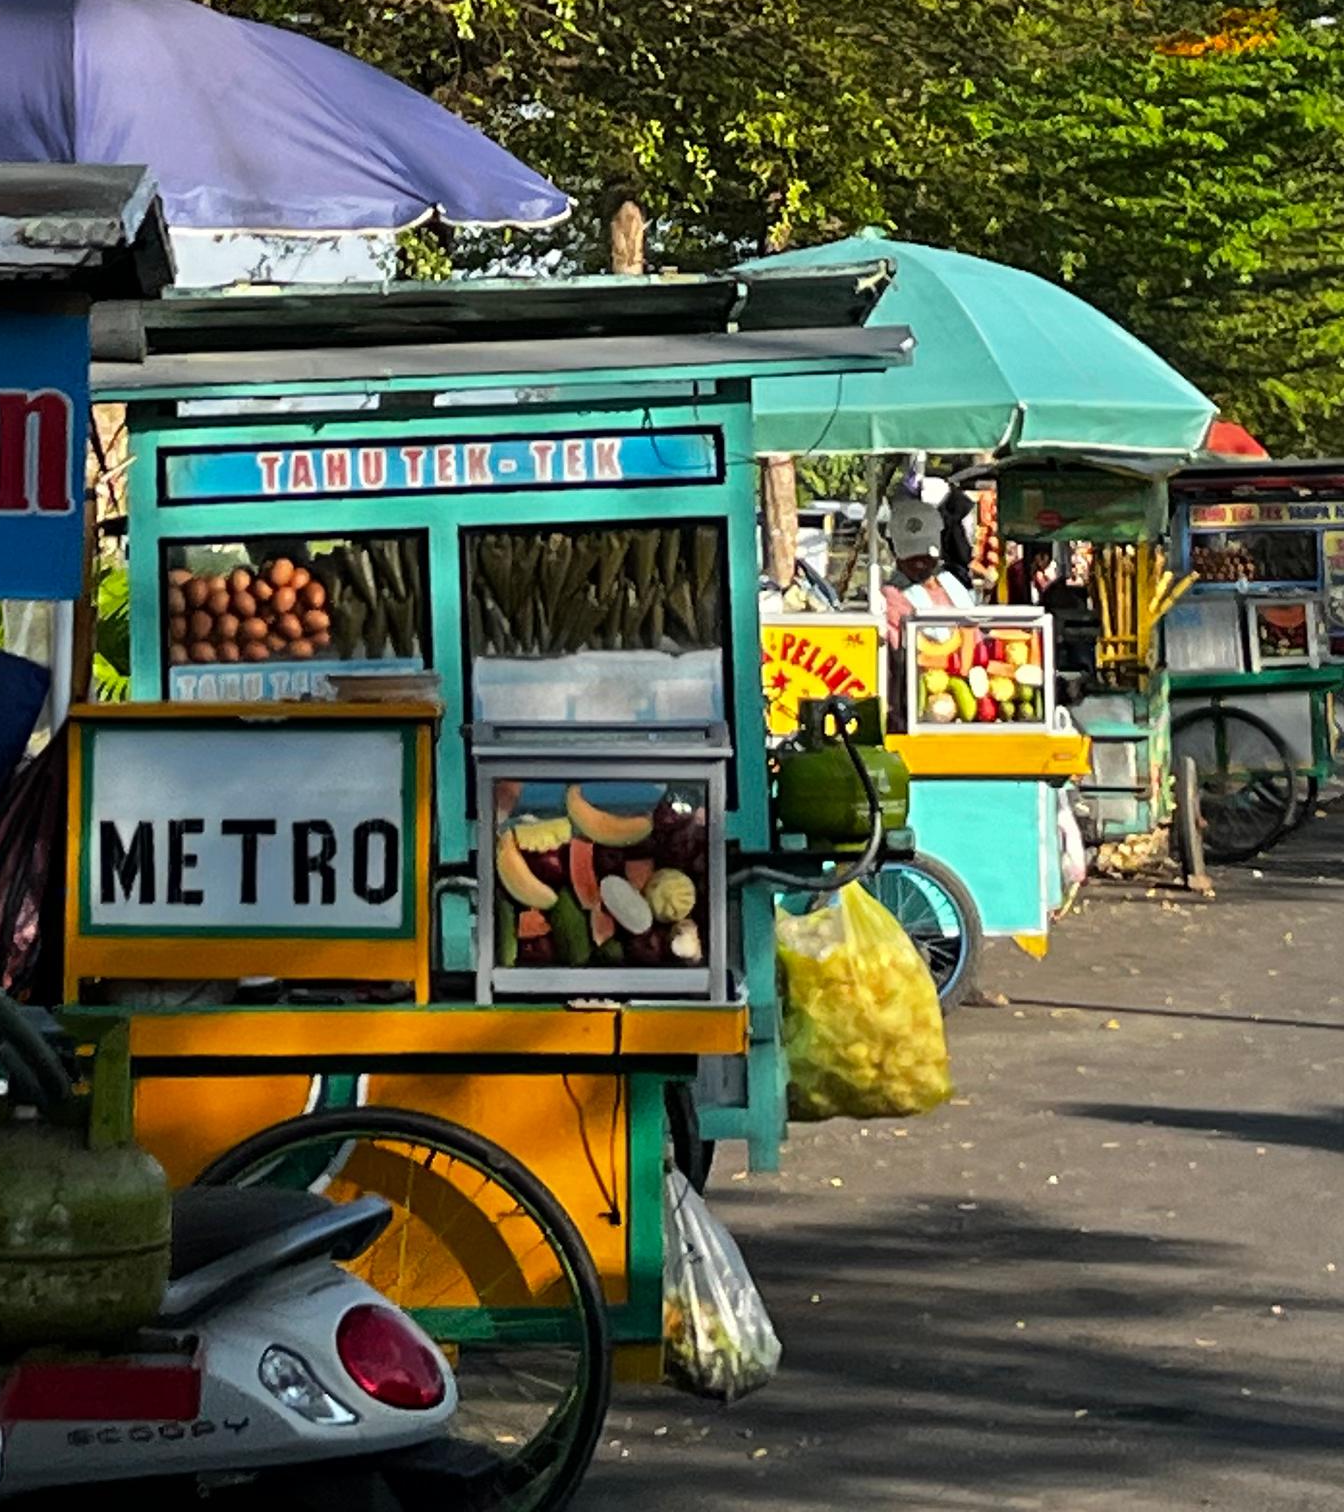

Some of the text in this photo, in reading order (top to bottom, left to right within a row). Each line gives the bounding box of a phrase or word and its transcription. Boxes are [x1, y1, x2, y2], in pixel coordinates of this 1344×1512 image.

[257, 447, 387, 494] TAHU
[100, 818, 399, 905] METRO
[67, 1416, 250, 1447] SCOOPY
